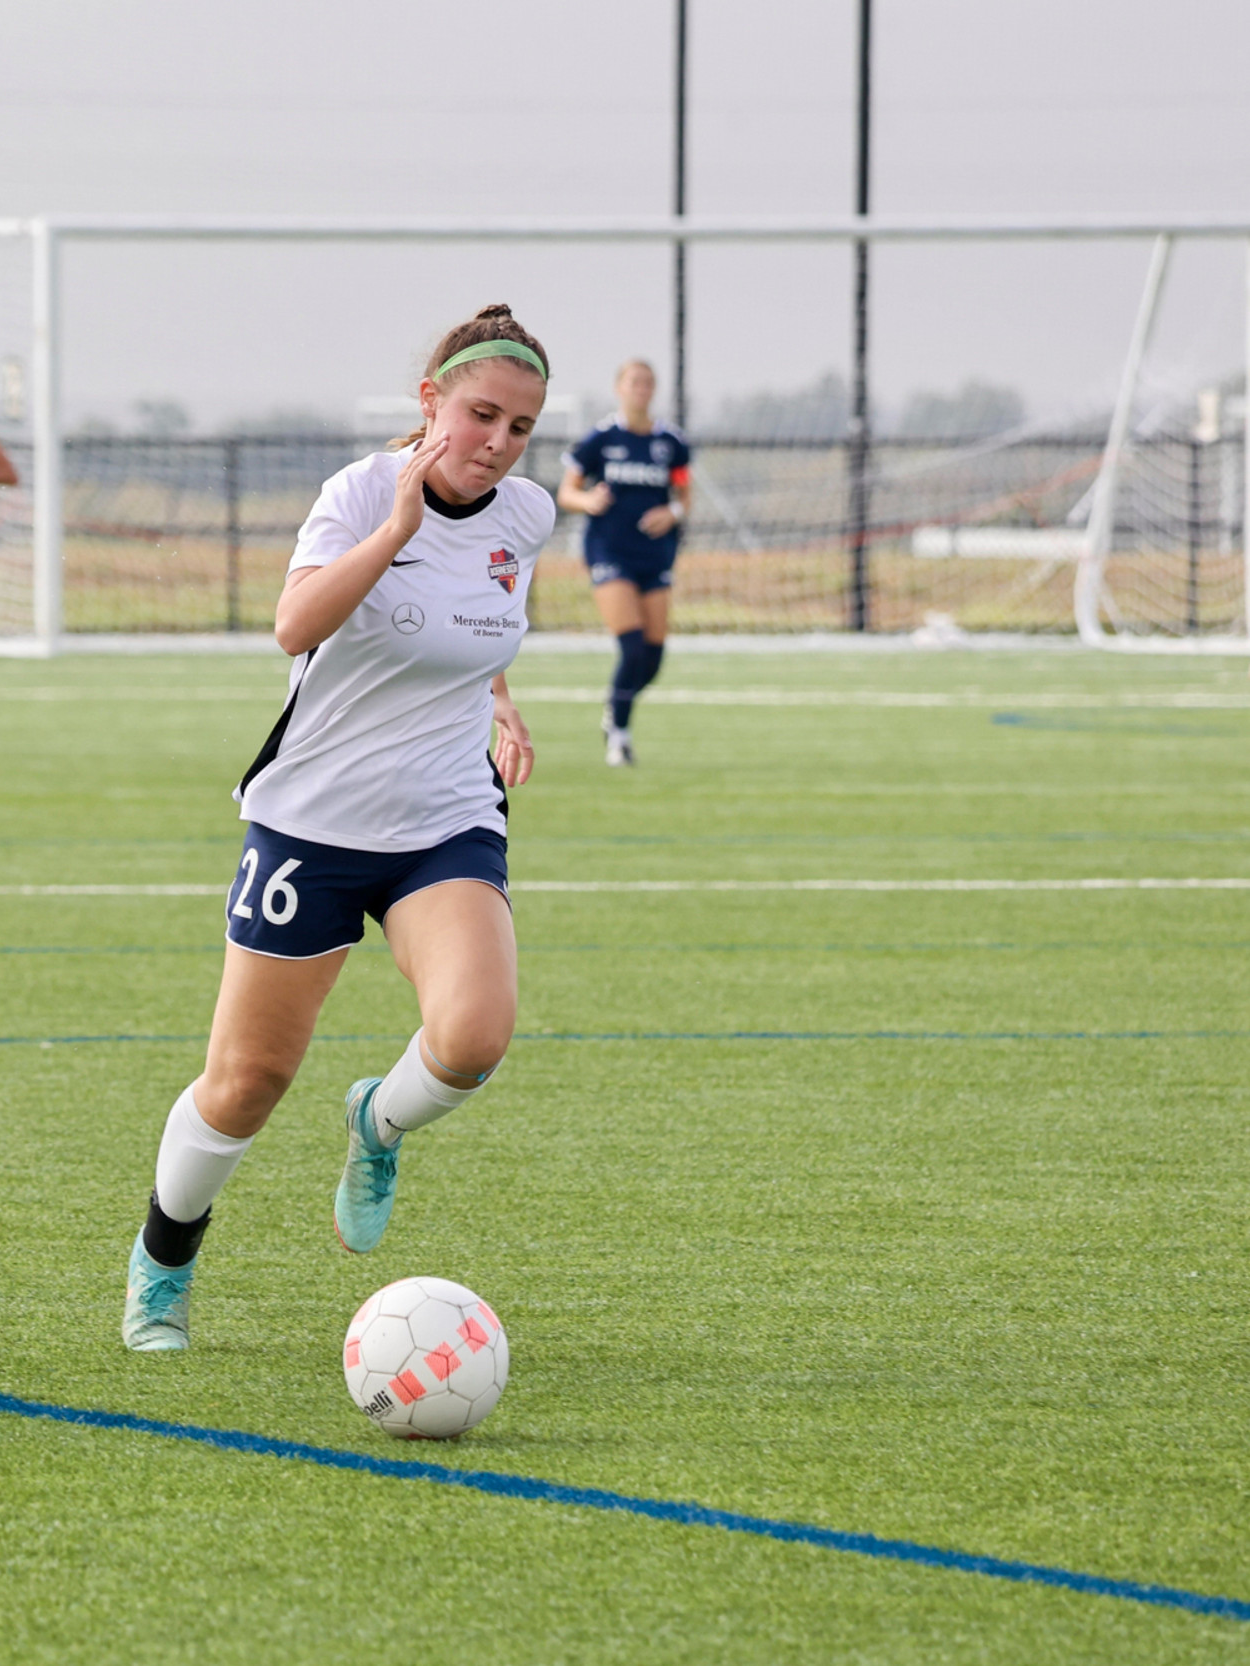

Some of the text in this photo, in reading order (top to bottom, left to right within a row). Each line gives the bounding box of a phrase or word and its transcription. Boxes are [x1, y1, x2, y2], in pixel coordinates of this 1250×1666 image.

[453, 614, 519, 629] Mercedes-Benz
[482, 629, 503, 638] Boerne
[231, 847, 303, 925] 26
[361, 1390, 393, 1417] pelli
